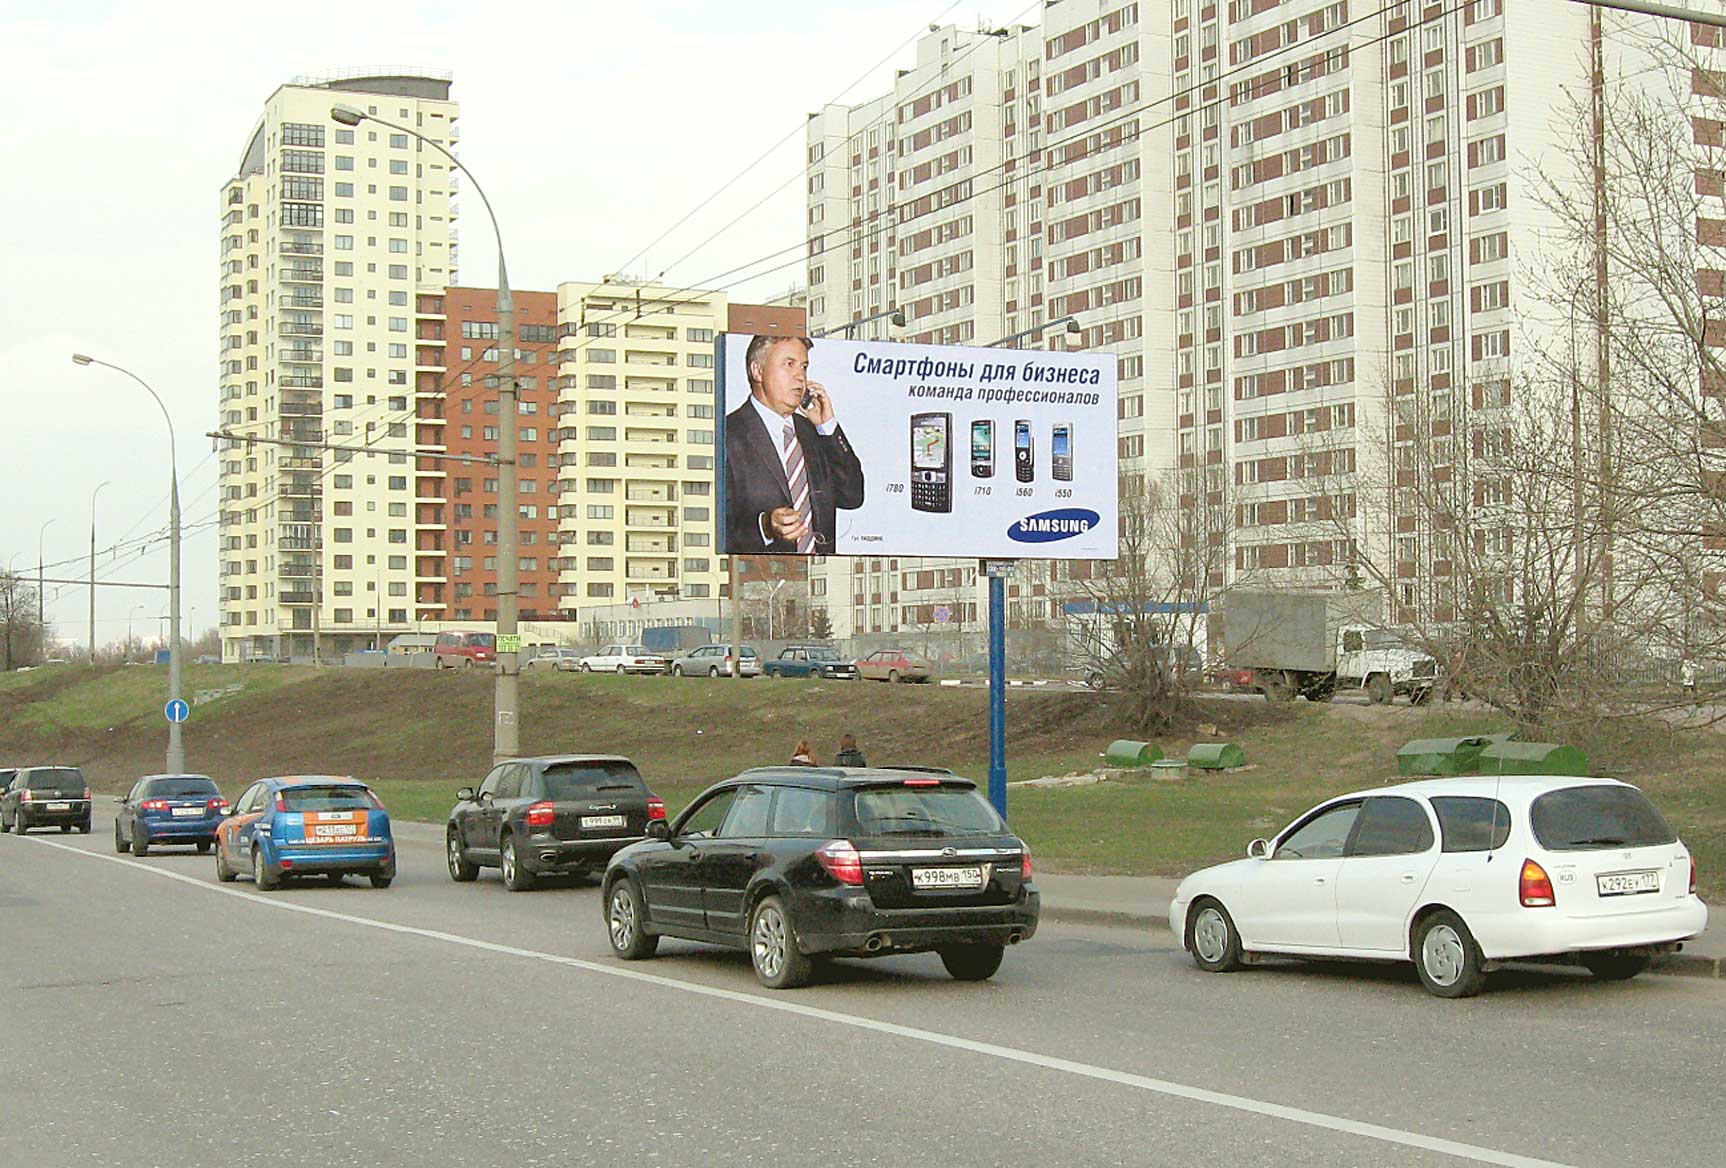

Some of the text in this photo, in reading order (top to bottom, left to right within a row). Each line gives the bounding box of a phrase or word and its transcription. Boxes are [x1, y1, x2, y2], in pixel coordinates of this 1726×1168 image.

[853, 352, 1101, 385] Смартфоны для бизнеса
[908, 385, 1100, 405] команда профессионалов
[886, 484, 904, 493] i780
[974, 486, 992, 496] i710
[1016, 487, 1033, 497] i560
[1054, 488, 1072, 498] i550
[1019, 517, 1089, 533] SAMSUNG
[305, 836, 334, 844] ЦЕЗАРЬ
[335, 835, 368, 843] ПАТРУЛЬ
